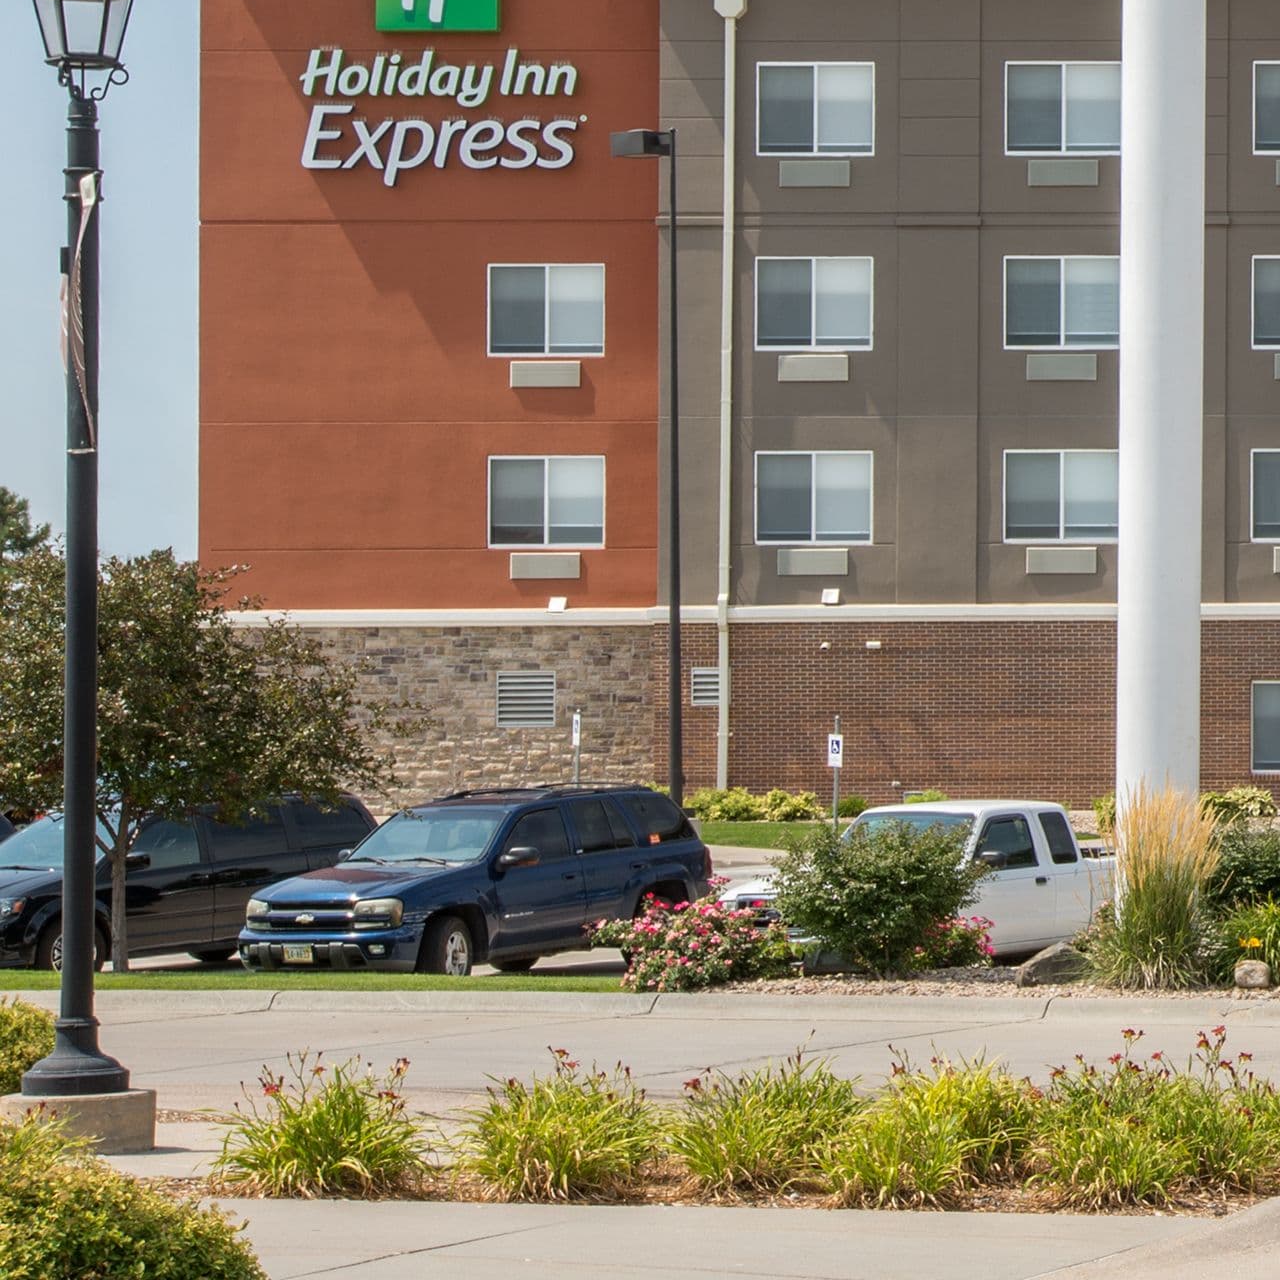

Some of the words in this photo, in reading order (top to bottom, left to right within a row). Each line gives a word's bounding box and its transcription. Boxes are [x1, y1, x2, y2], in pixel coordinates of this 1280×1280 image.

[299, 48, 494, 108] Holiday
[500, 48, 578, 96] Inn
[301, 105, 578, 188] Express
